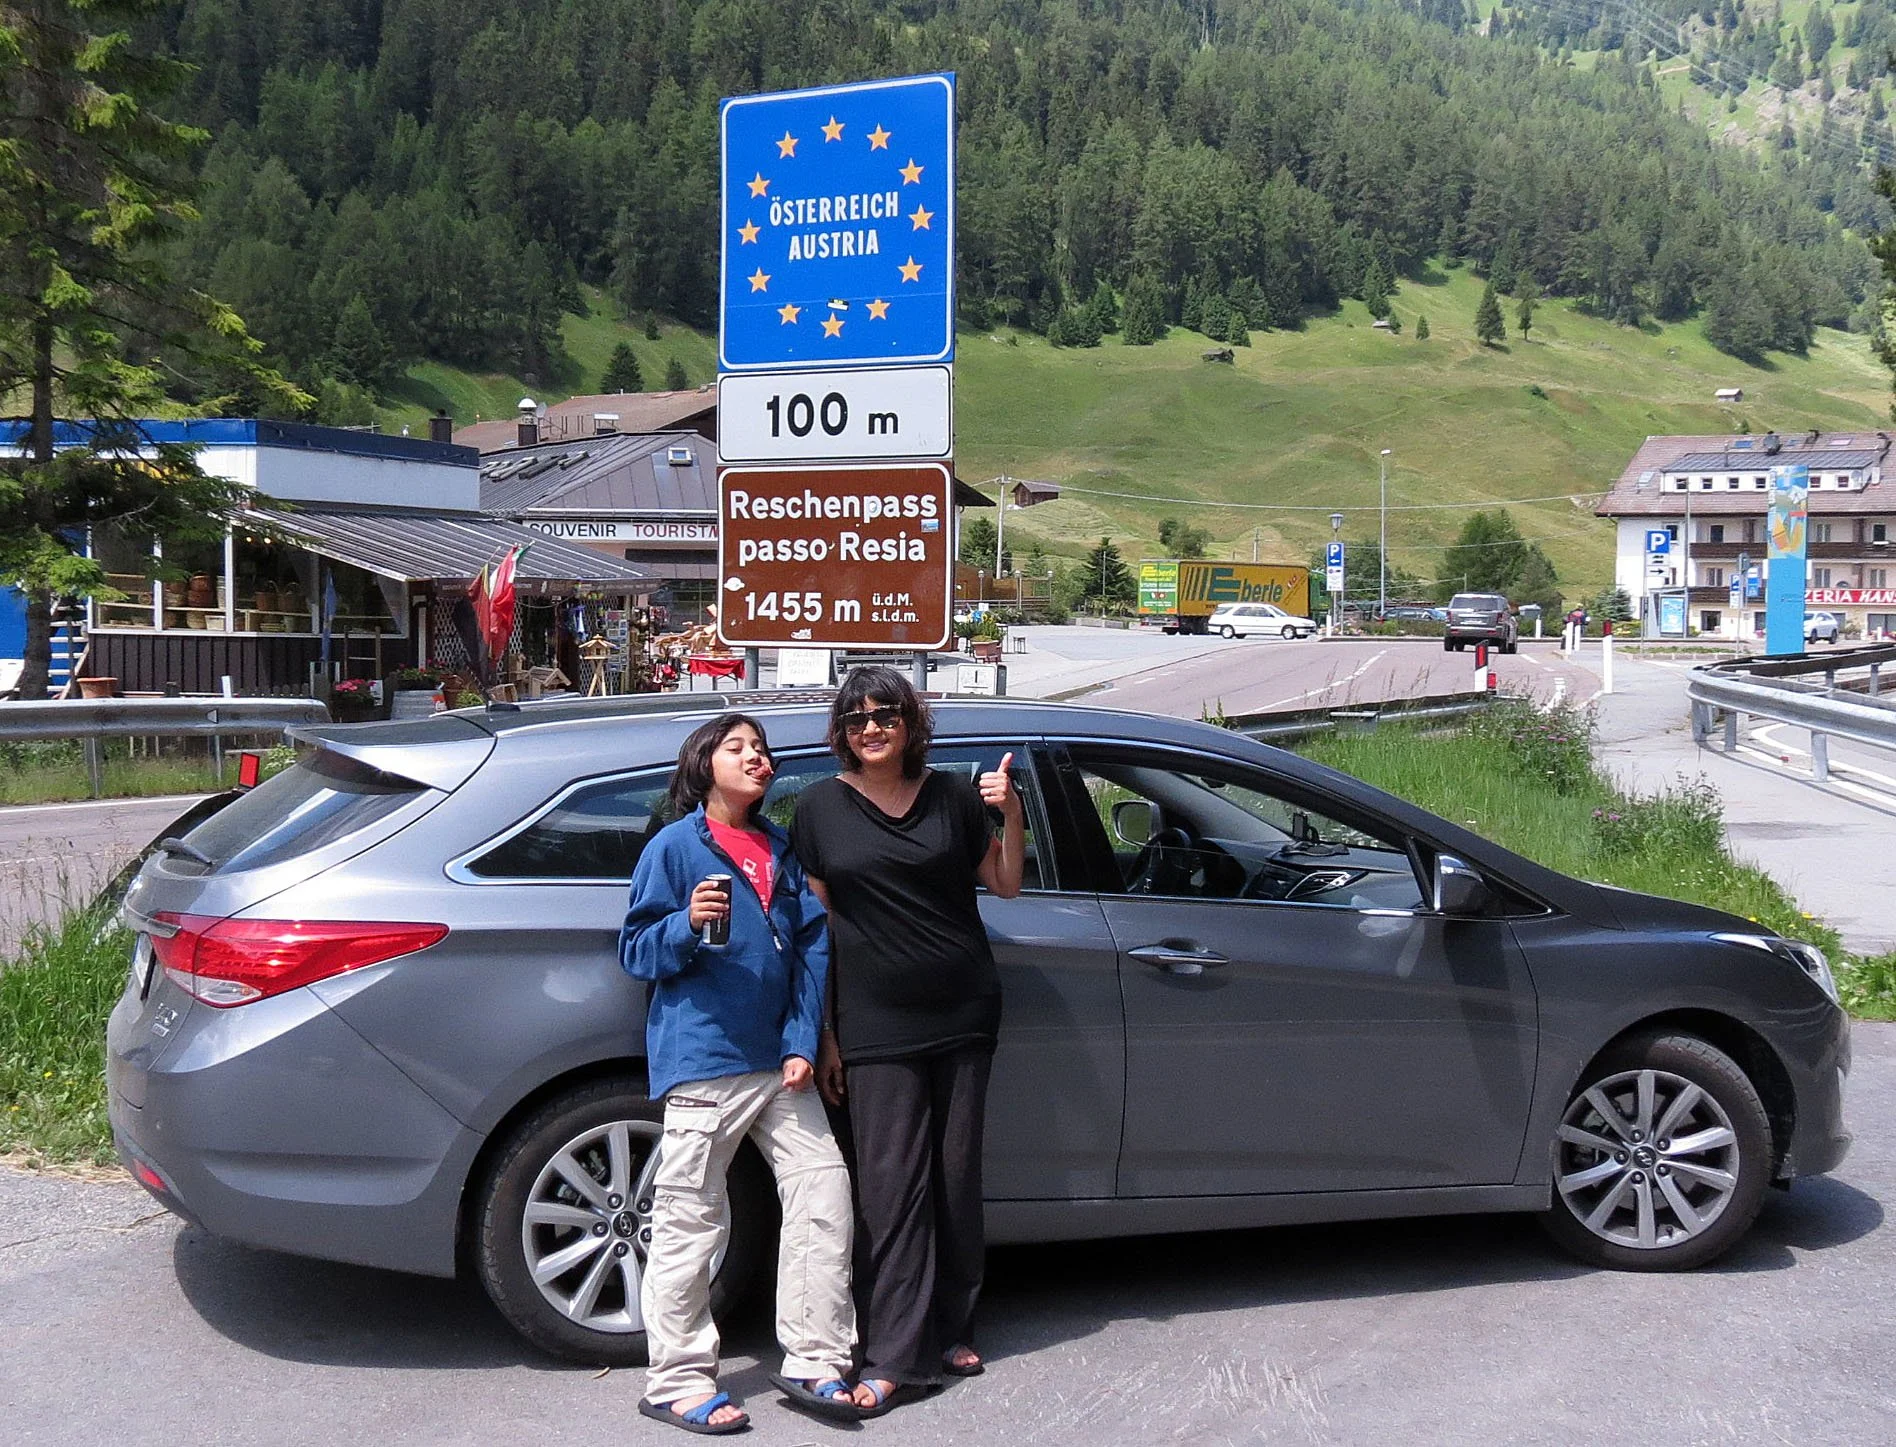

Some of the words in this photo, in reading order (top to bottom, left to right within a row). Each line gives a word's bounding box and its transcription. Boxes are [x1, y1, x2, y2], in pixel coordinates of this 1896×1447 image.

[769, 191, 899, 226] ÖSTERREICH
[788, 229, 880, 261] AUSTRIA
[766, 391, 849, 438] 100
[868, 411, 899, 435] m
[730, 489, 937, 523] Reschenpass
[739, 538, 828, 567] passo
[840, 531, 926, 562] Resia
[1330, 544, 1340, 557] P
[1650, 532, 1666, 551] P
[1208, 567, 1283, 603] Eberle
[1859, 590, 1896, 603] HAN
[744, 592, 823, 623] 1455
[834, 599, 861, 622] m
[872, 592, 914, 607] ü.d.M.
[871, 609, 920, 623] s.l.d.m.
